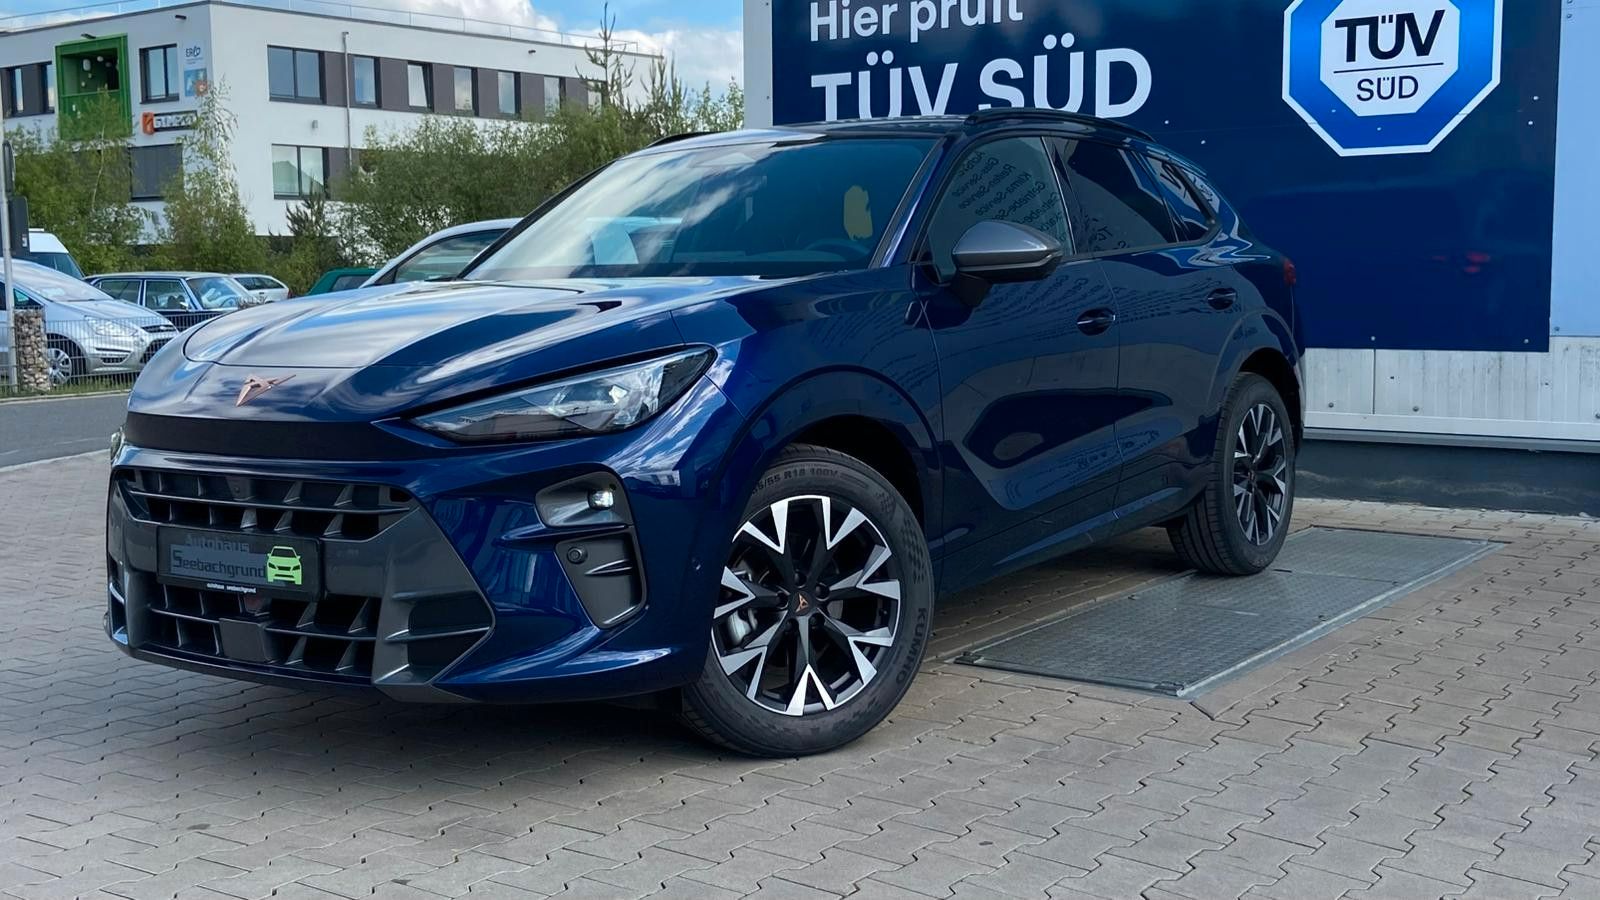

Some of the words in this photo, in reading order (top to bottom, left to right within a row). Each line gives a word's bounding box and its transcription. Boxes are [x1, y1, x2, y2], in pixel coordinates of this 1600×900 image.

[810, 0, 898, 42] Hier
[1335, 9, 1446, 63] TÜV
[811, 50, 959, 122] TÜV
[978, 32, 1152, 119] SÜD
[1356, 75, 1419, 102] SÜD
[172, 550, 267, 578] Seebachgrund
[185, 534, 250, 552] Autohaus
[896, 607, 927, 685] KUMHO
